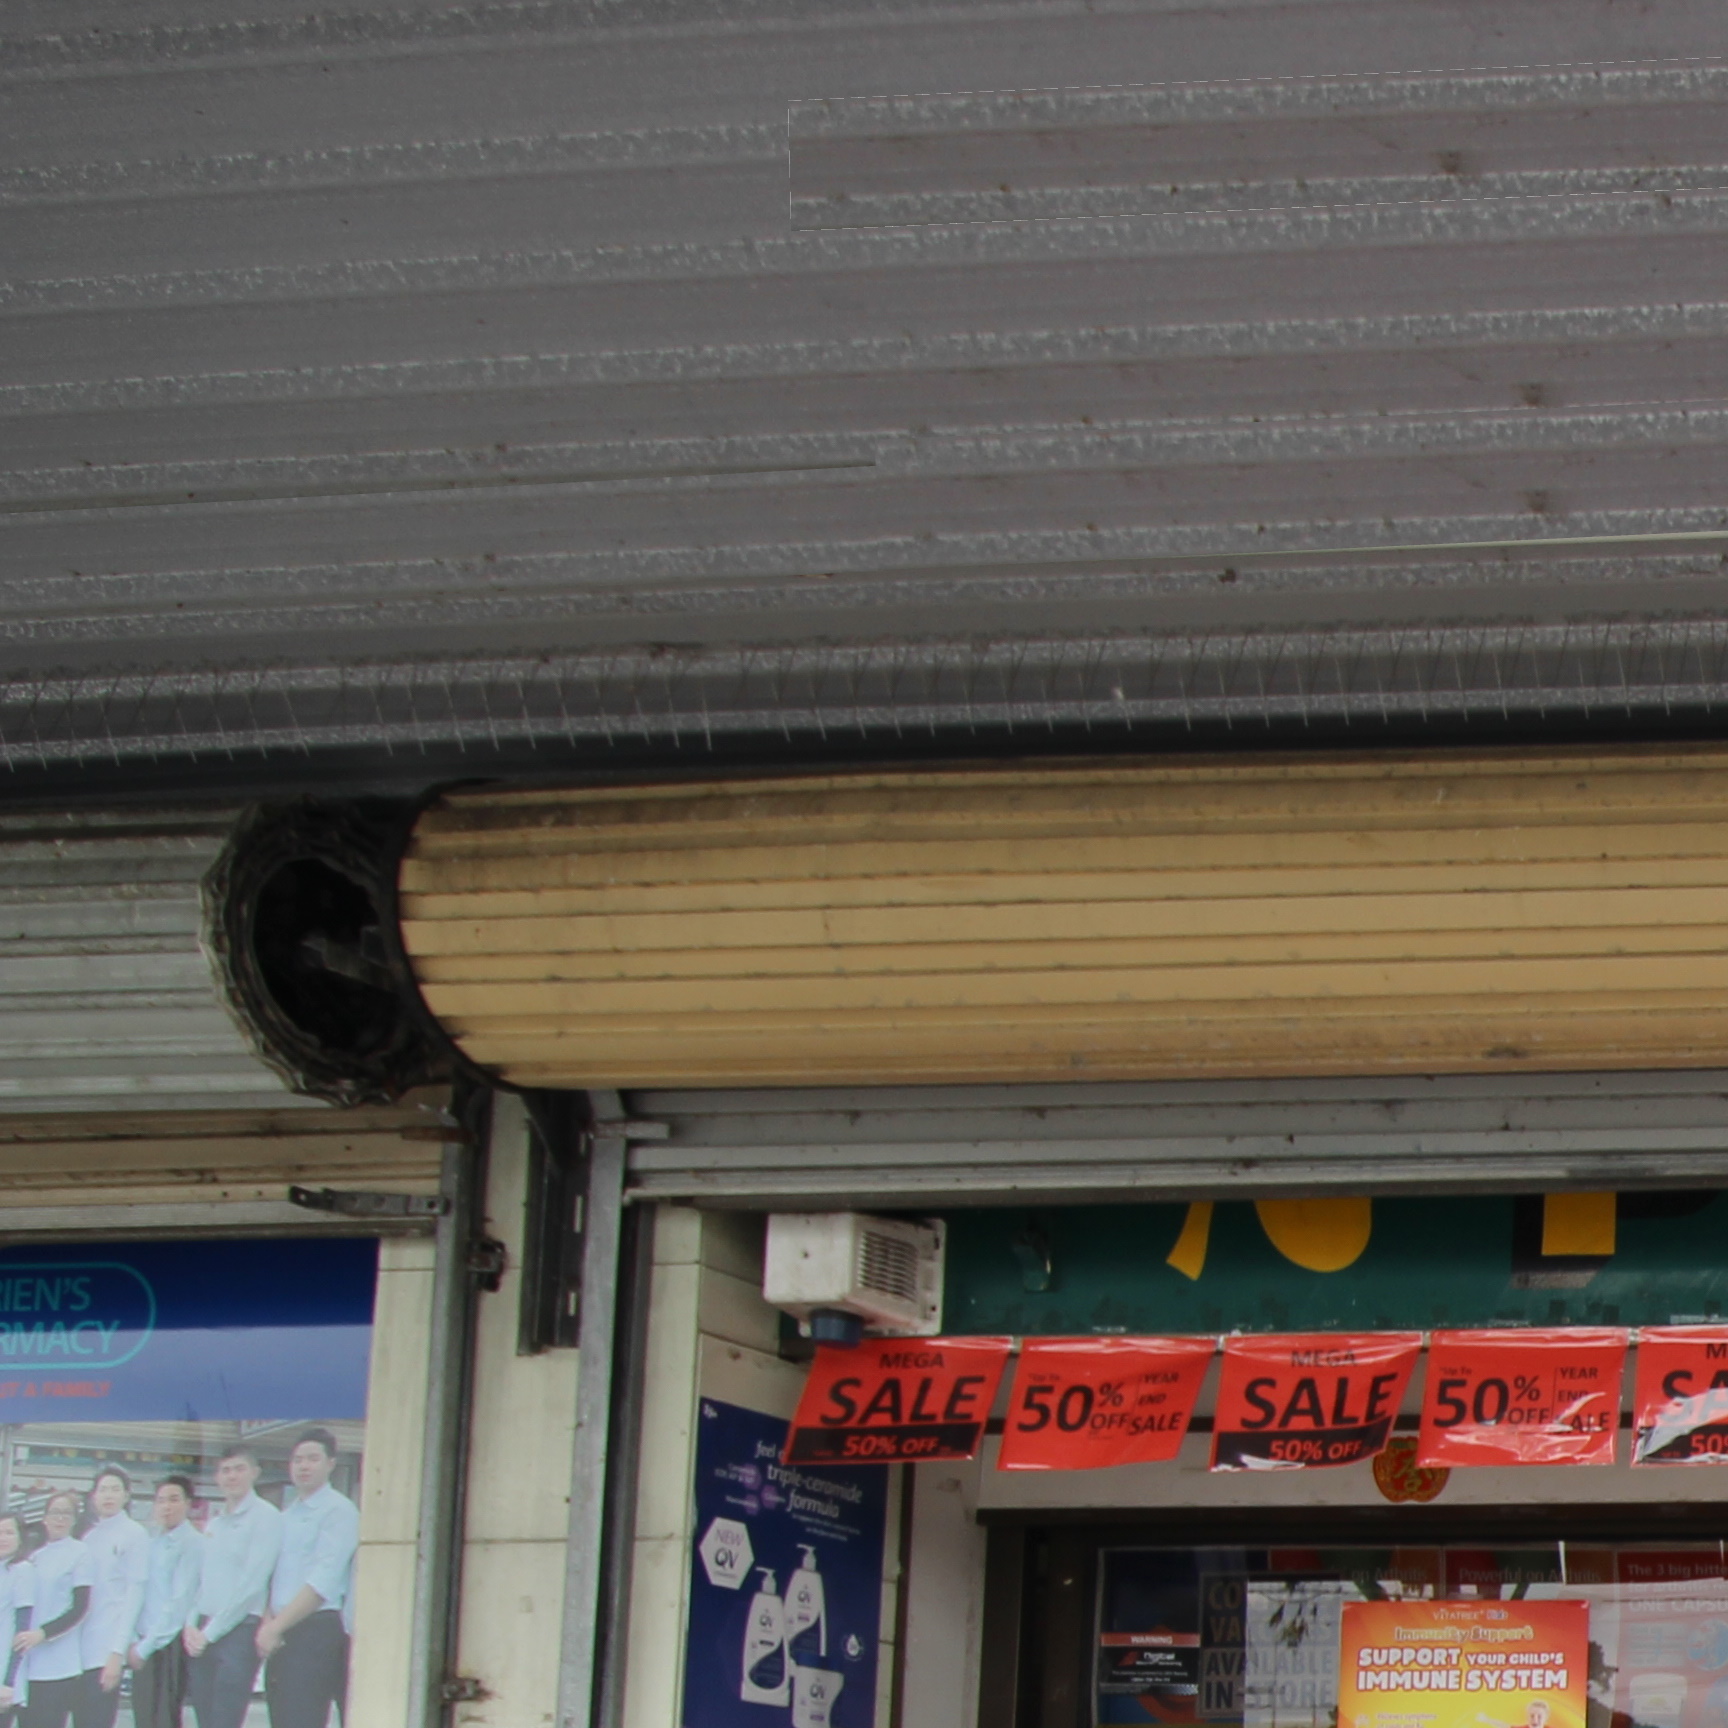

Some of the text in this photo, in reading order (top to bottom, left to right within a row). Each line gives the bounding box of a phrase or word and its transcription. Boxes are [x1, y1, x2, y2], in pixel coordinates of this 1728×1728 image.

[880, 1353, 944, 1368] MEGA
[1291, 1351, 1355, 1367] MEGA
[1144, 1373, 1179, 1383] YEAR
[1558, 1366, 1598, 1379] YEAR
[820, 1375, 986, 1425] SALE
[1241, 1373, 1398, 1430] SALE
[1128, 1412, 1183, 1435] SALE
[843, 1435, 938, 1455] 50% OFF
[1270, 1438, 1360, 1460] 50% OFF
[767, 1464, 863, 1504] triple-ceramide
[787, 1490, 840, 1518] formula
[714, 1548, 740, 1570] QV
[1626, 1563, 1653, 1577] The
[1394, 1625, 1534, 1642] Immunity Support
[1358, 1648, 1564, 1667] SUPPORT YOUR CHILD'S
[1357, 1669, 1568, 1691] IMMUNE SYSTEM
